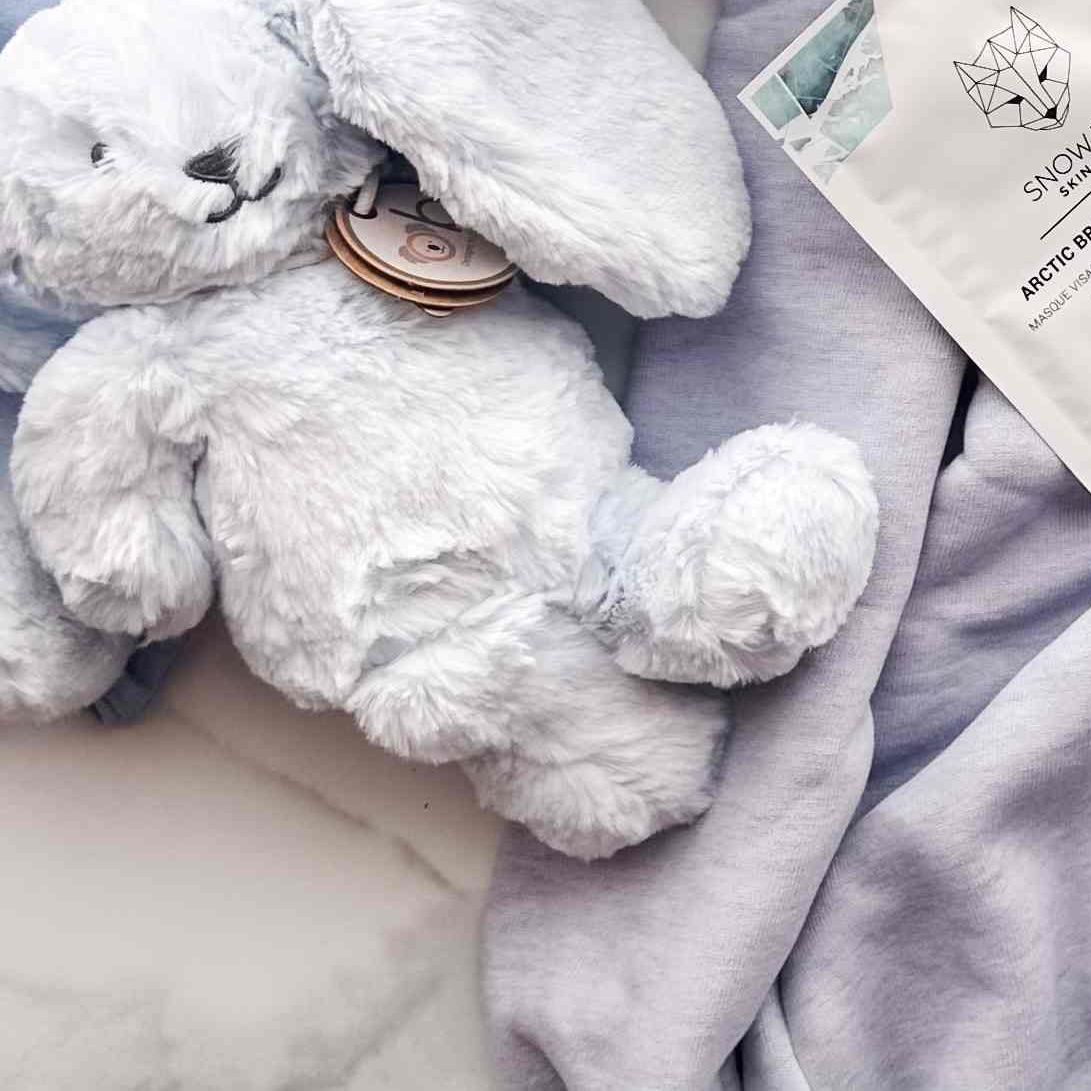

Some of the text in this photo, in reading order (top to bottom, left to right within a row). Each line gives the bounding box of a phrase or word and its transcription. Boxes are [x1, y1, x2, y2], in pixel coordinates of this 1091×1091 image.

[1023, 133, 1091, 202] SNOW
[1021, 246, 1075, 301] ARCTIC
[1028, 289, 1072, 331] MASQUE
